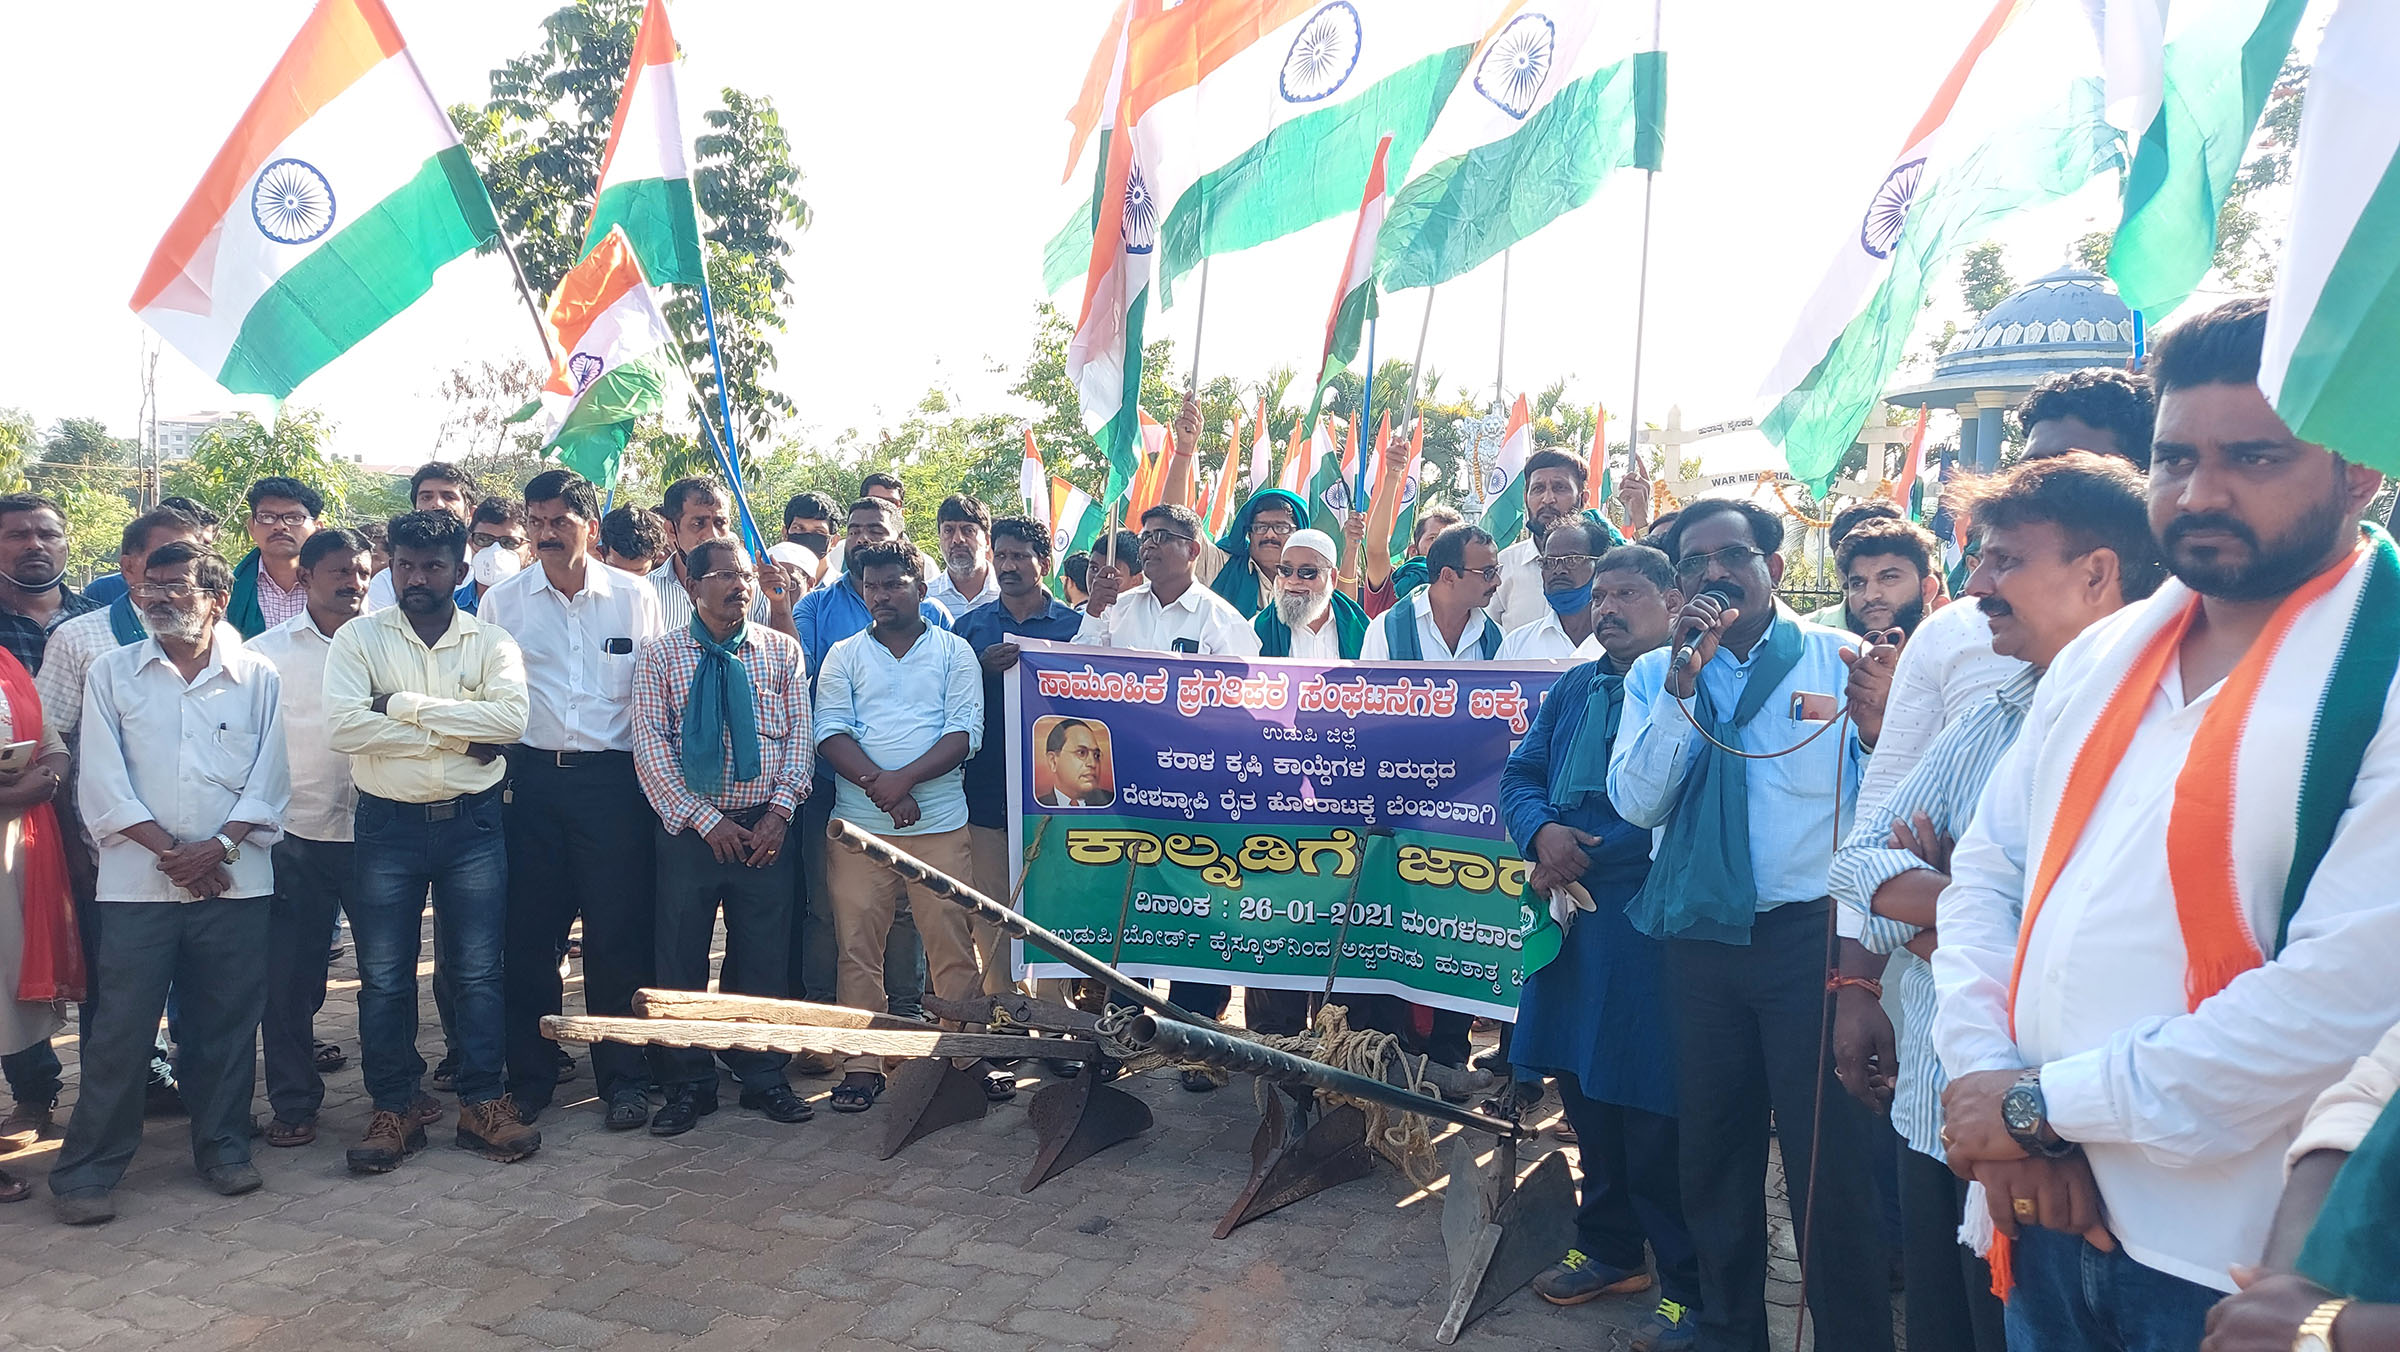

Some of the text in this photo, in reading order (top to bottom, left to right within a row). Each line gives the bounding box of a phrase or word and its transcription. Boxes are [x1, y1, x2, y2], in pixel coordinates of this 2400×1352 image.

[1711, 471, 1797, 487] WAR MEMRIAL
[1037, 664, 1529, 734] ಸಾಮೂಹಿಕ ಪ್ರಗತಿಪರ ಸಂಘಟನೆಗಳ ಐಕ್ಯ
[1262, 724, 1357, 751] ಉಡುಪಿ ಜಿಲ್ಲೆ
[1157, 746, 1456, 790] ಕರಾಳ ಕೃಷಿ ಕಾಯ್ದೆಗಳ ವಿರುದ್ಧದ
[1122, 783, 1497, 826] ದೇಶವ್ಯಾಪಿ ರೈತ ಹೋರಾಟಕ್ಕೆ ಬೆಂಬಲವಾಗಿ
[1066, 827, 1358, 889] ಕಾಲ್ನಡಿಗೆ
[1134, 891, 1212, 917] ದಿನಾಂಕ
[1222, 900, 1229, 918] :
[1239, 897, 1394, 927] 26-01-2021
[1123, 924, 1201, 948] ಬೋರ್ಡ್
[1341, 940, 1424, 970] ಅಜ್ಜರಕಾಡು
[1435, 954, 1502, 994] ಹುತಾತ್ಮ
